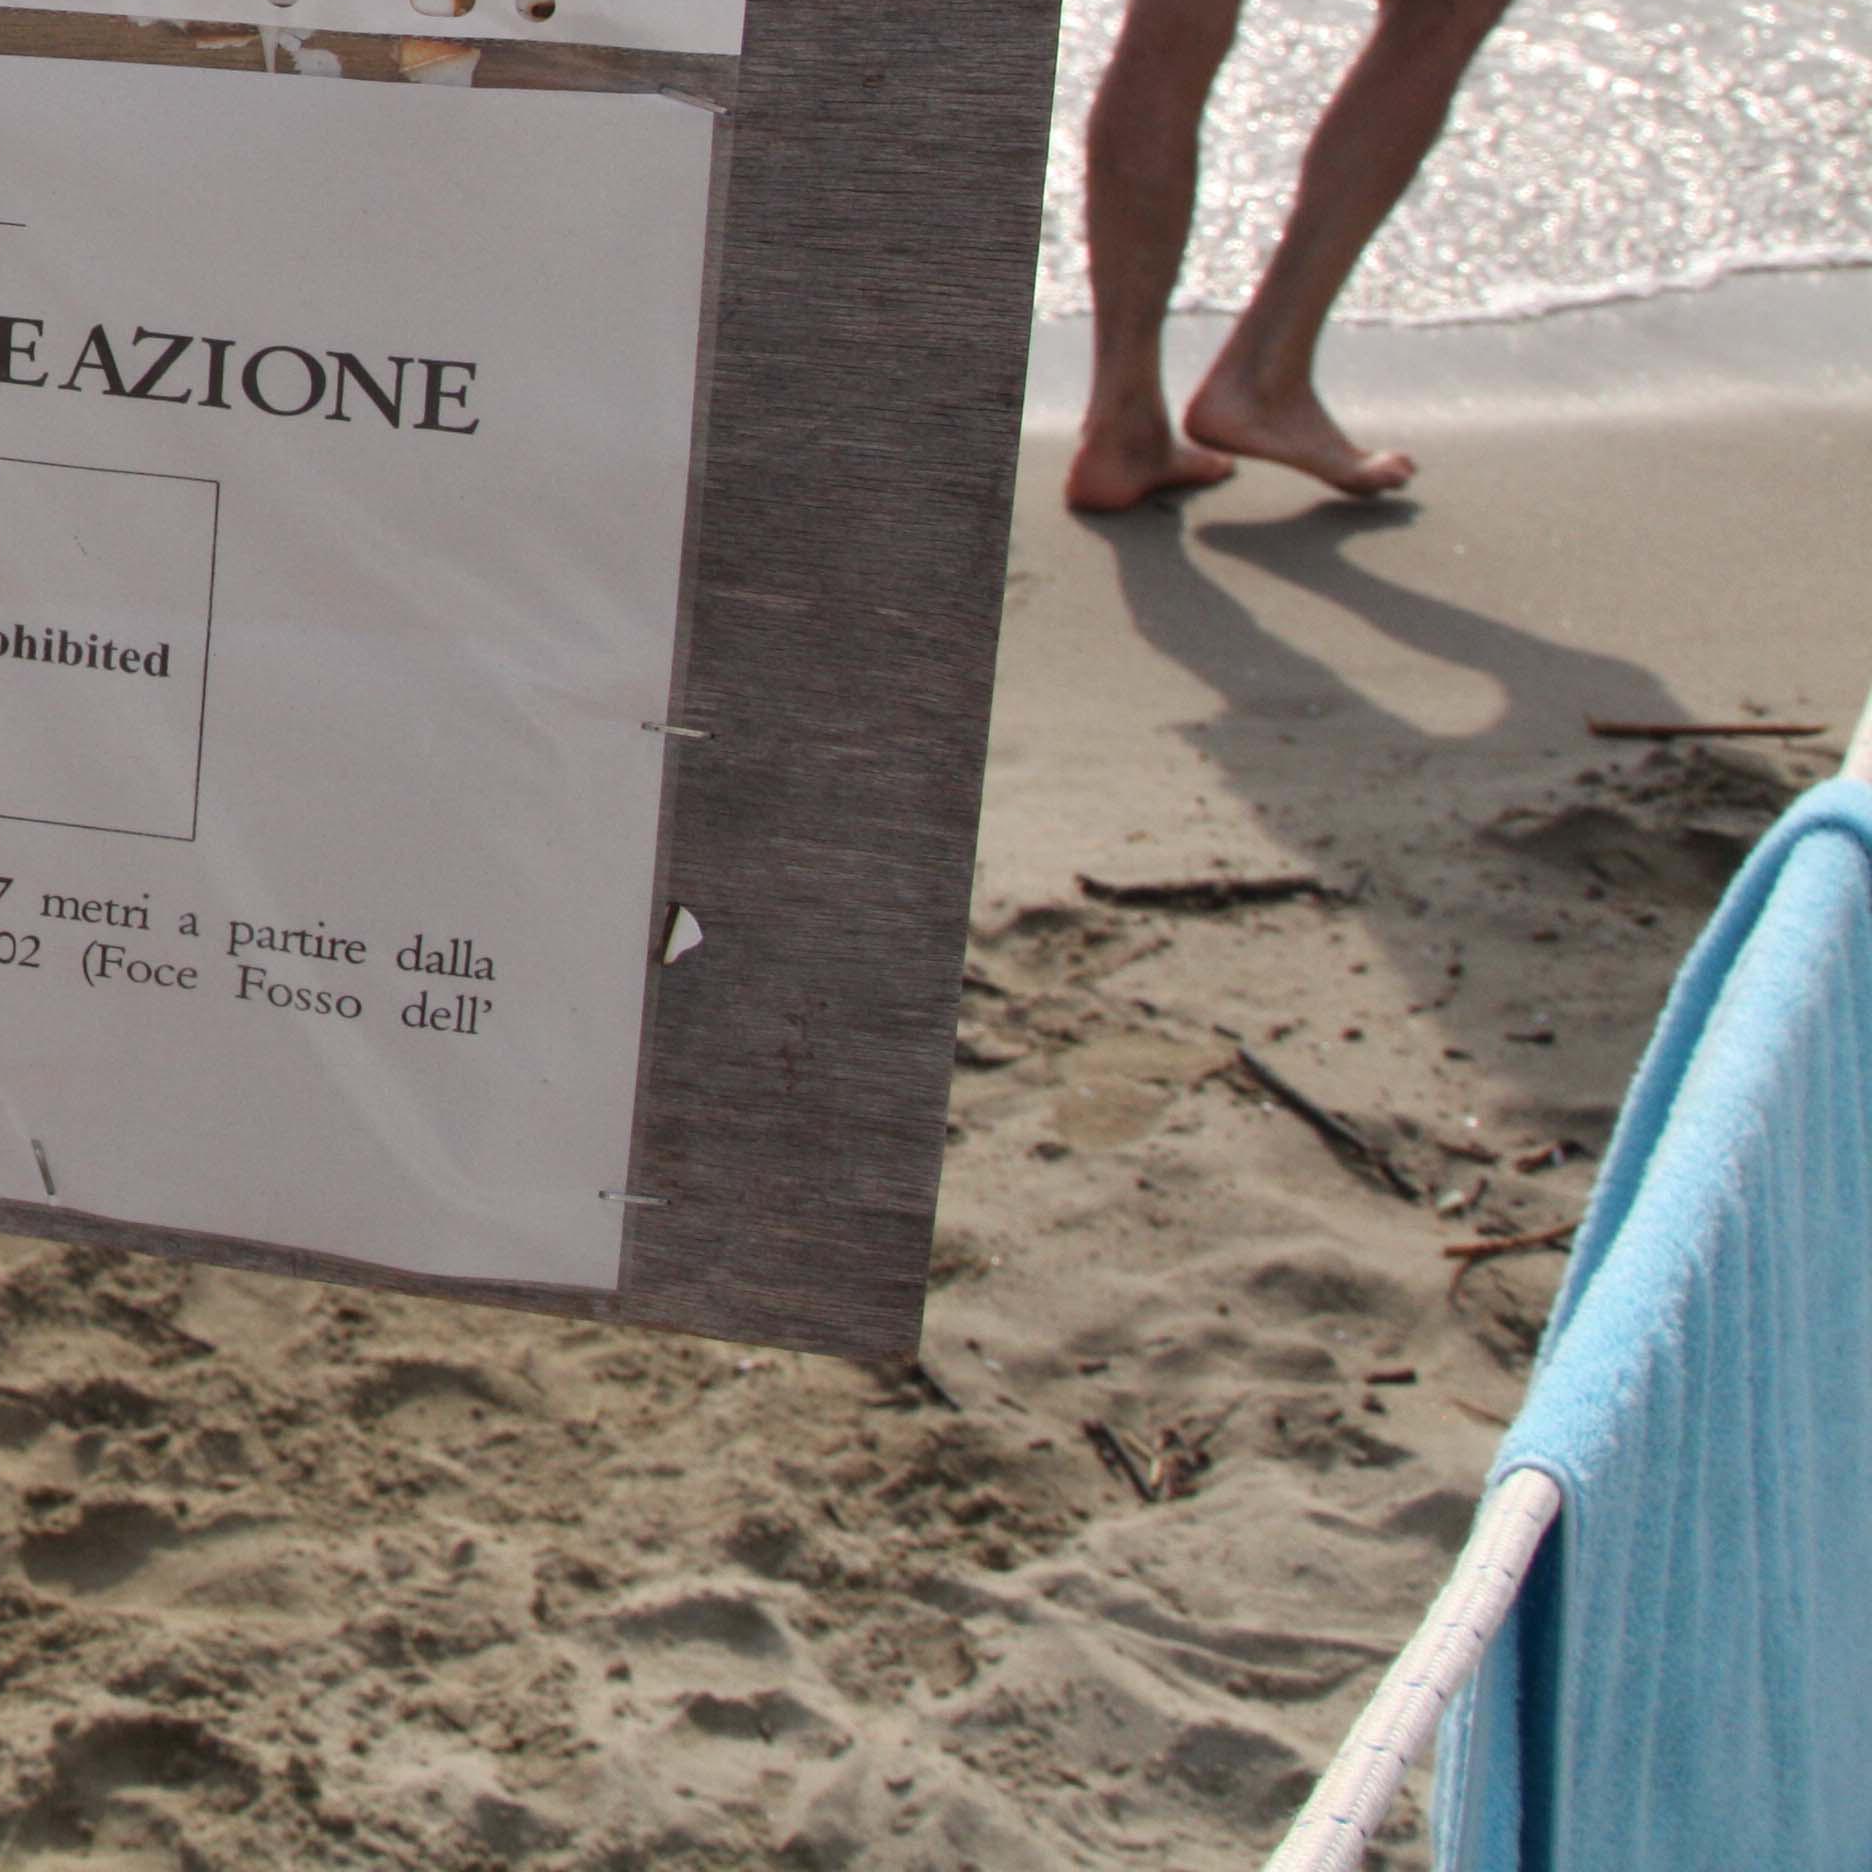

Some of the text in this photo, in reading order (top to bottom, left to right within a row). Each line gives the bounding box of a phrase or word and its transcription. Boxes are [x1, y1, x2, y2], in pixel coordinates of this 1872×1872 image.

[39, 893, 150, 931] metri
[178, 912, 200, 937] a
[226, 920, 367, 965] partire
[395, 933, 496, 982] dalla
[80, 939, 200, 989] (Foce
[235, 964, 363, 1019] Fosso
